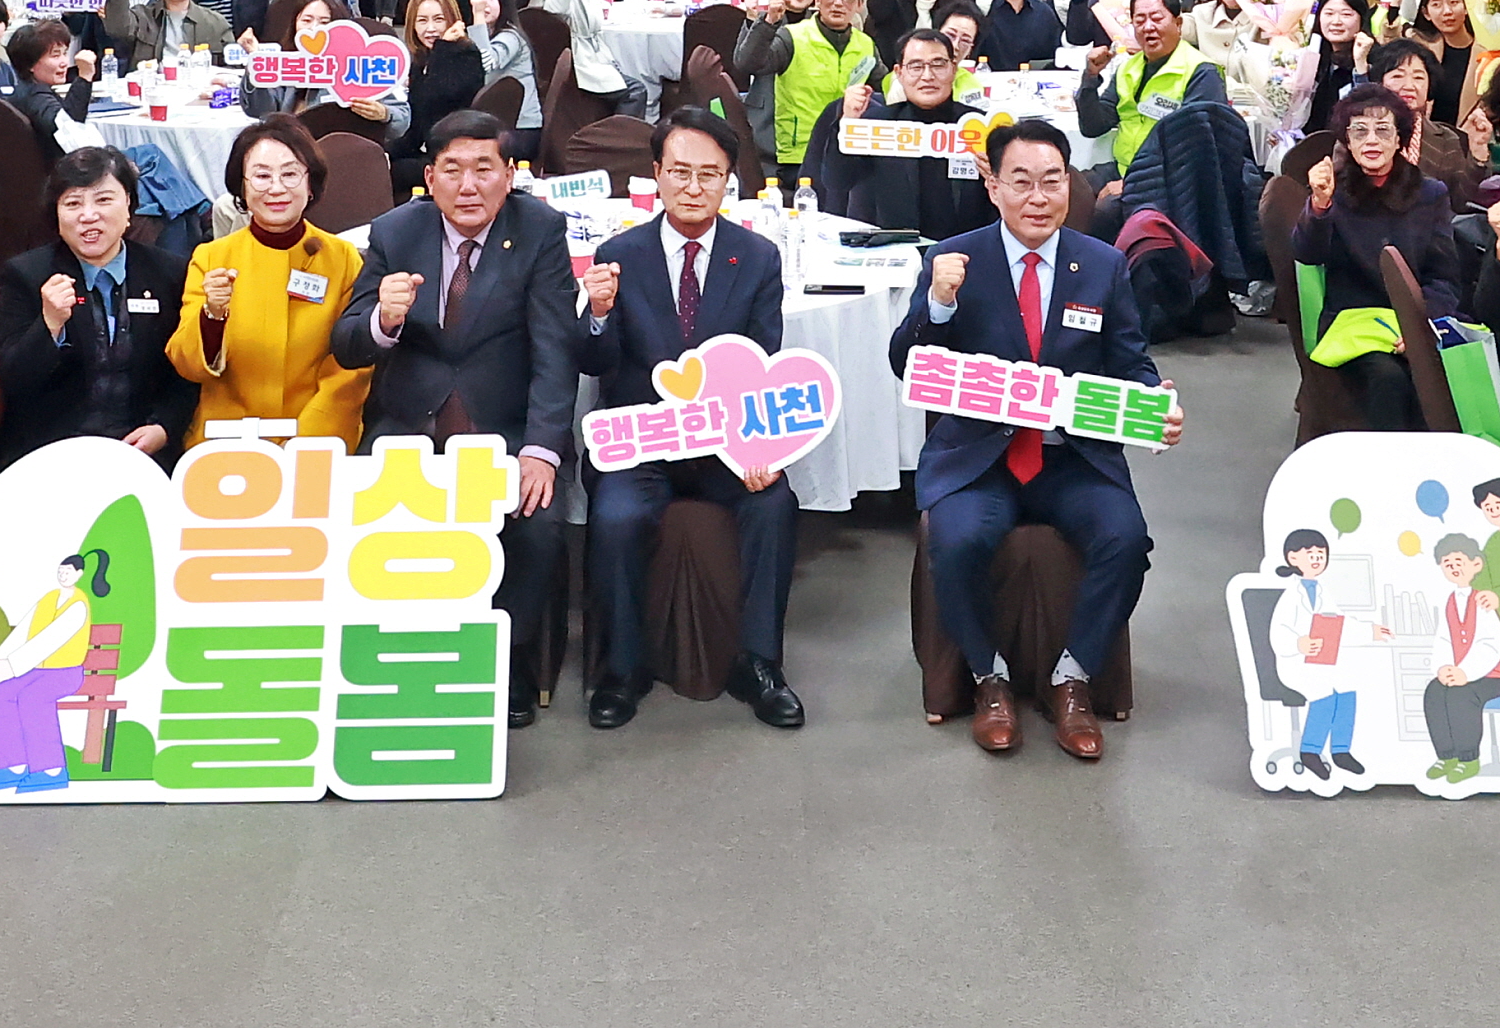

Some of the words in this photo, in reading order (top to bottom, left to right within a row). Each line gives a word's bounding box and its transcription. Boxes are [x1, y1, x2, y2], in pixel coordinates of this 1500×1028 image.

[252, 55, 336, 85] 행복한
[344, 57, 396, 85] 사천
[843, 123, 922, 153] 든든한
[930, 129, 982, 154] 이웃
[550, 176, 604, 200] 내빈석
[590, 398, 726, 464] 행복한
[740, 383, 824, 441] 사천
[908, 351, 1059, 424] 촘촘한
[1072, 380, 1170, 443] 돌봄
[172, 447, 507, 603] 일상
[152, 622, 499, 790] 돌봄
